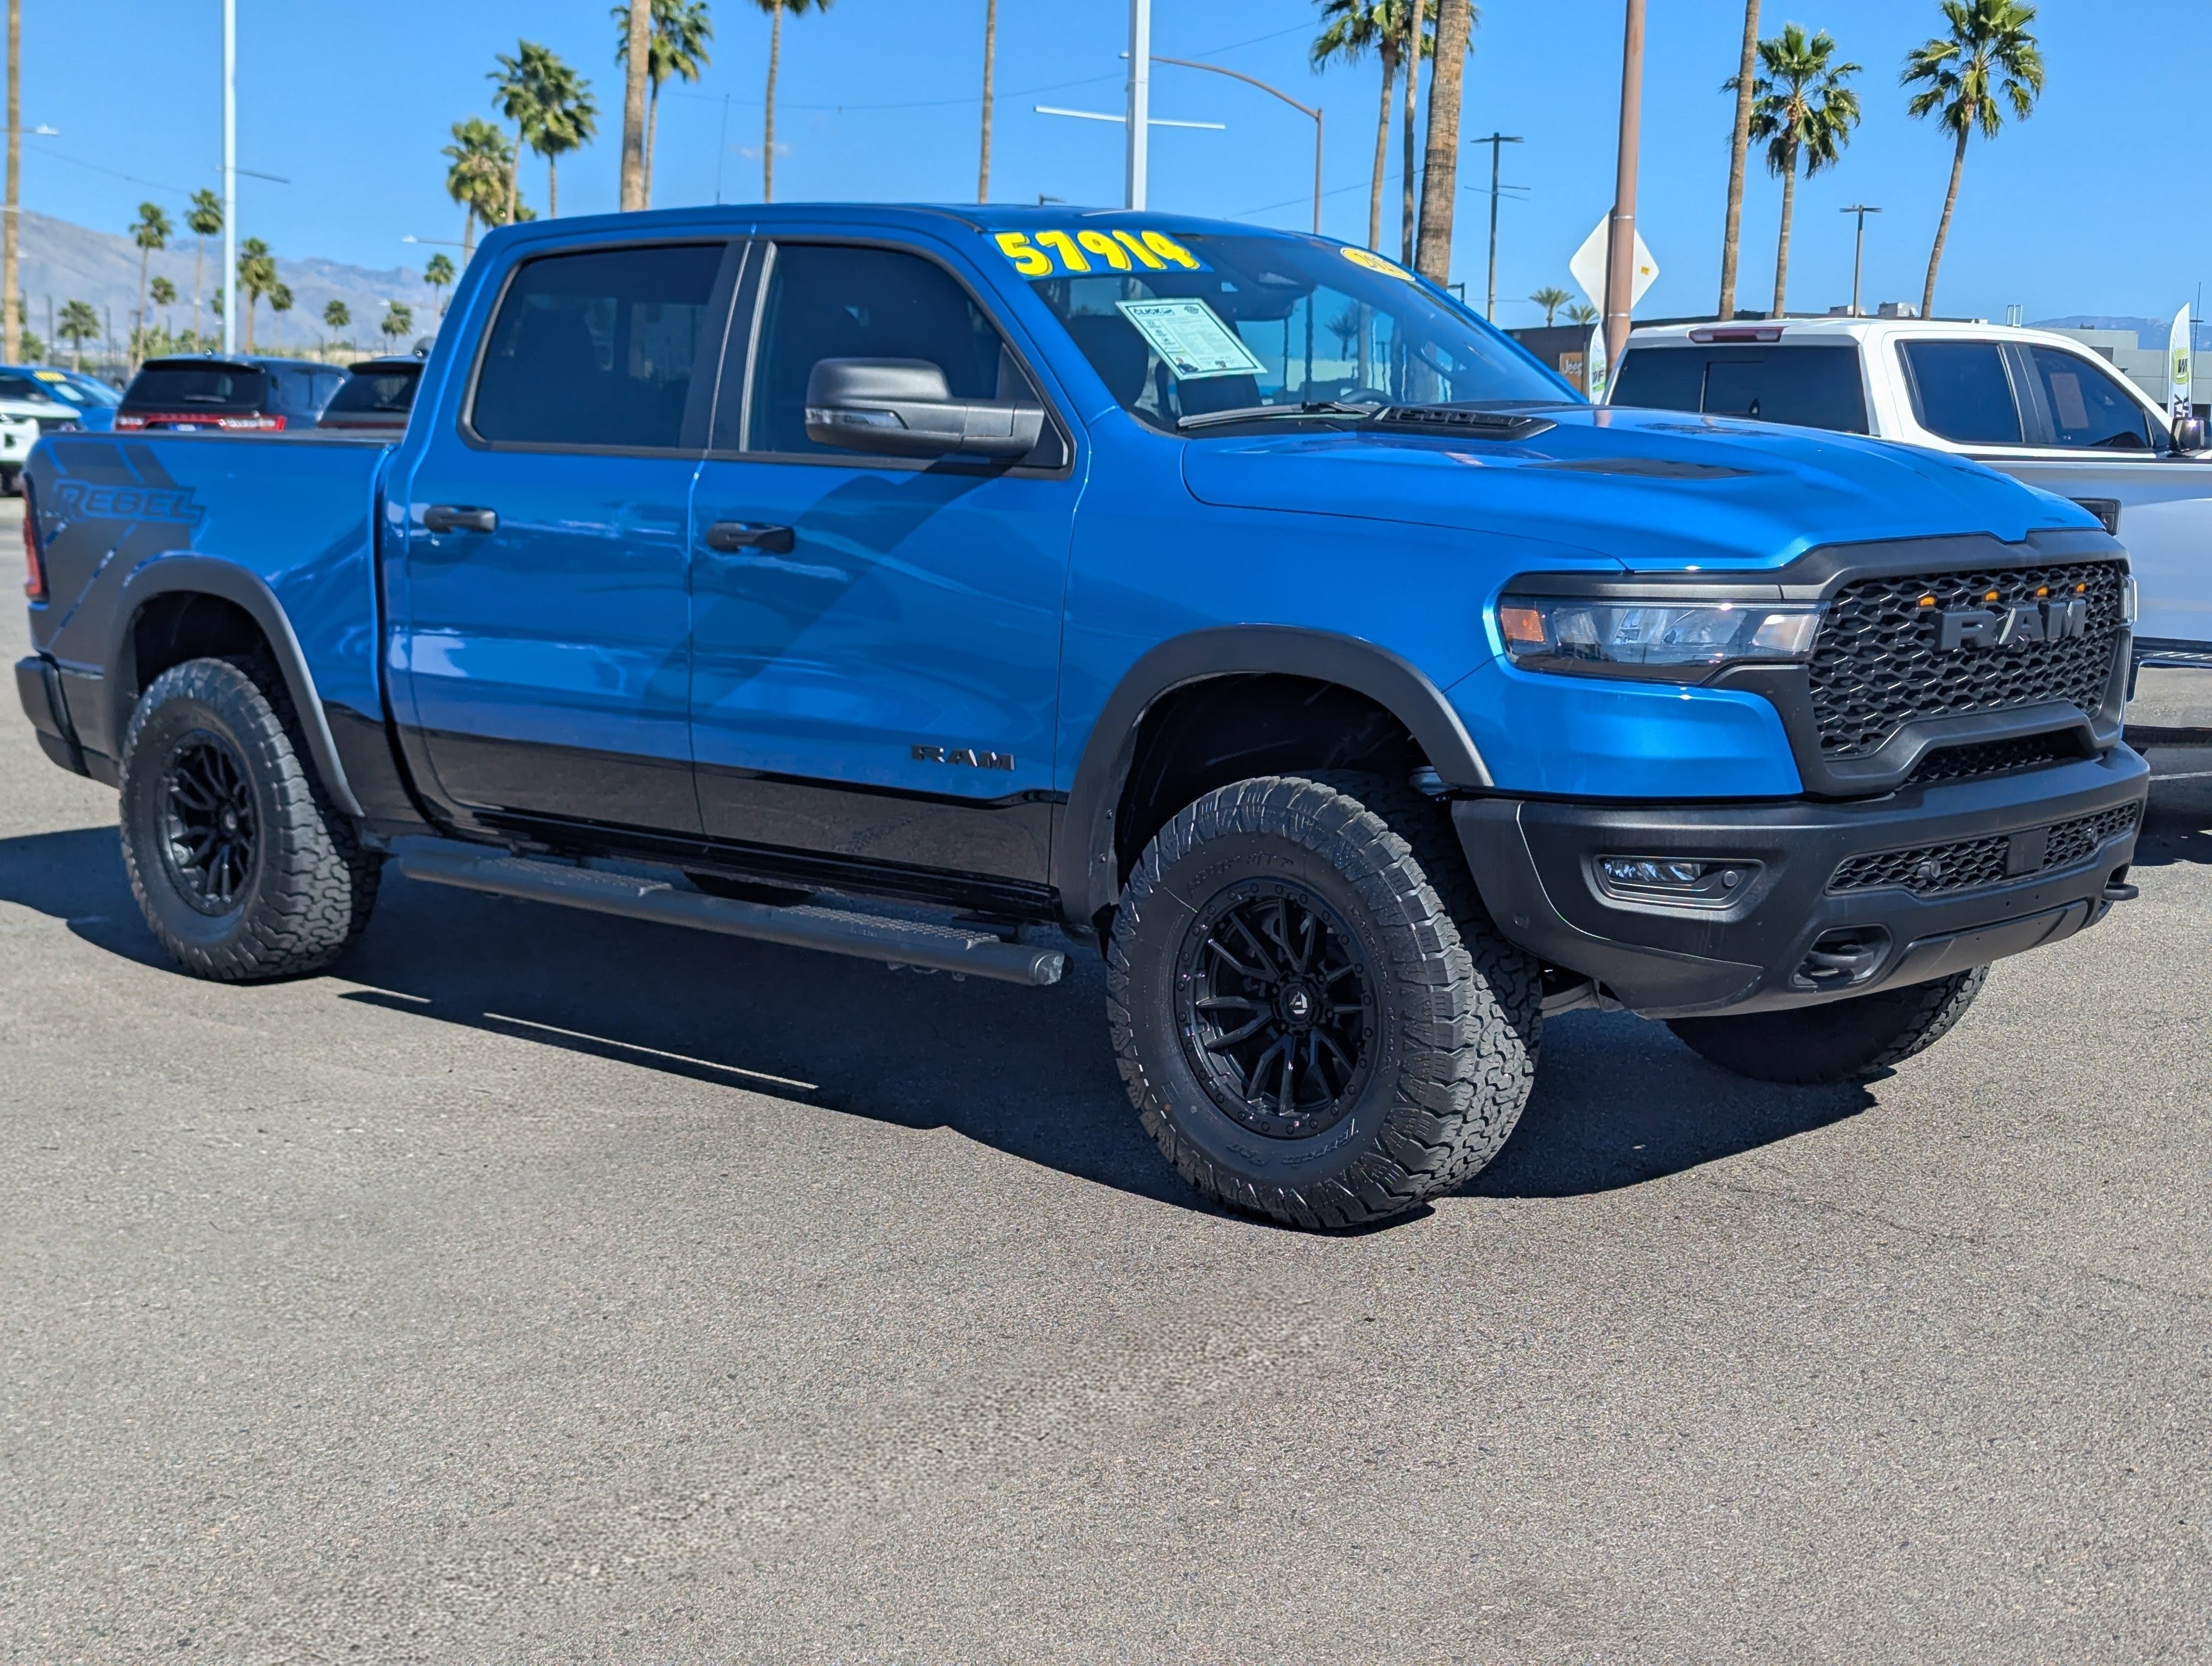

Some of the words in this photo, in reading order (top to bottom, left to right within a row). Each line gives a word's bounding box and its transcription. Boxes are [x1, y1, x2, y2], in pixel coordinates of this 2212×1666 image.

[994, 230, 1200, 277] 57914
[1562, 358, 1583, 377] Jeep
[53, 479, 206, 525] REBEL
[1940, 599, 2087, 651] RAM
[911, 744, 1015, 771] RAM
